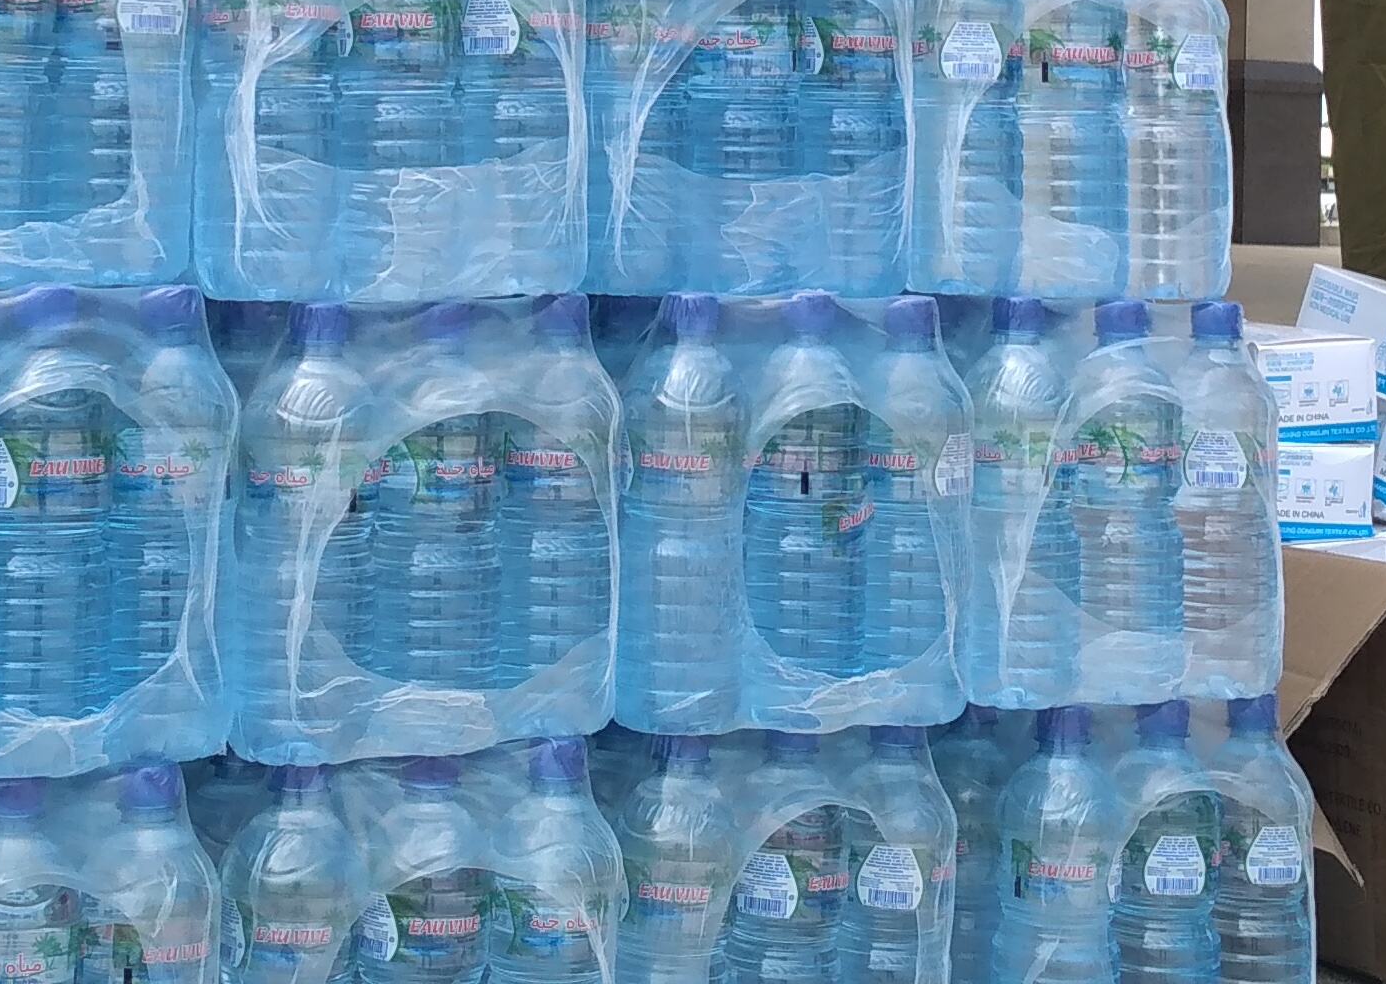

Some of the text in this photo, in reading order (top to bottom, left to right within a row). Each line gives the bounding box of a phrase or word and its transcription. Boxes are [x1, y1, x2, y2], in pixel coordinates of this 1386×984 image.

[286, 4, 318, 18] EAU
[361, 14, 433, 28] EAU VIVE
[726, 30, 757, 46] مياه
[1054, 47, 1114, 62] EAU VIVE
[1126, 53, 1155, 65] VIVE
[1296, 414, 1304, 422] IN
[1305, 413, 1329, 421] CHINA
[1331, 427, 1354, 435] TEXTILE
[121, 456, 189, 475] مياه حية
[508, 450, 574, 467] EAU VIVE
[641, 453, 710, 470] EAU VIVE
[882, 454, 915, 468] VIVE
[30, 459, 105, 476] EAU VIVE
[275, 466, 307, 484] مياه
[436, 464, 462, 477] حية
[1293, 510, 1300, 518] IN
[1302, 511, 1324, 519] CHINA
[1028, 862, 1094, 879] EAU VIVE
[808, 876, 836, 890] EAU
[638, 884, 710, 902] EAU VIVE
[409, 916, 480, 934] EAU VIVE
[531, 918, 558, 930] حية
[255, 927, 332, 944] EAU VIVE
[143, 946, 179, 962] EAU
[5, 954, 43, 974] مياه
